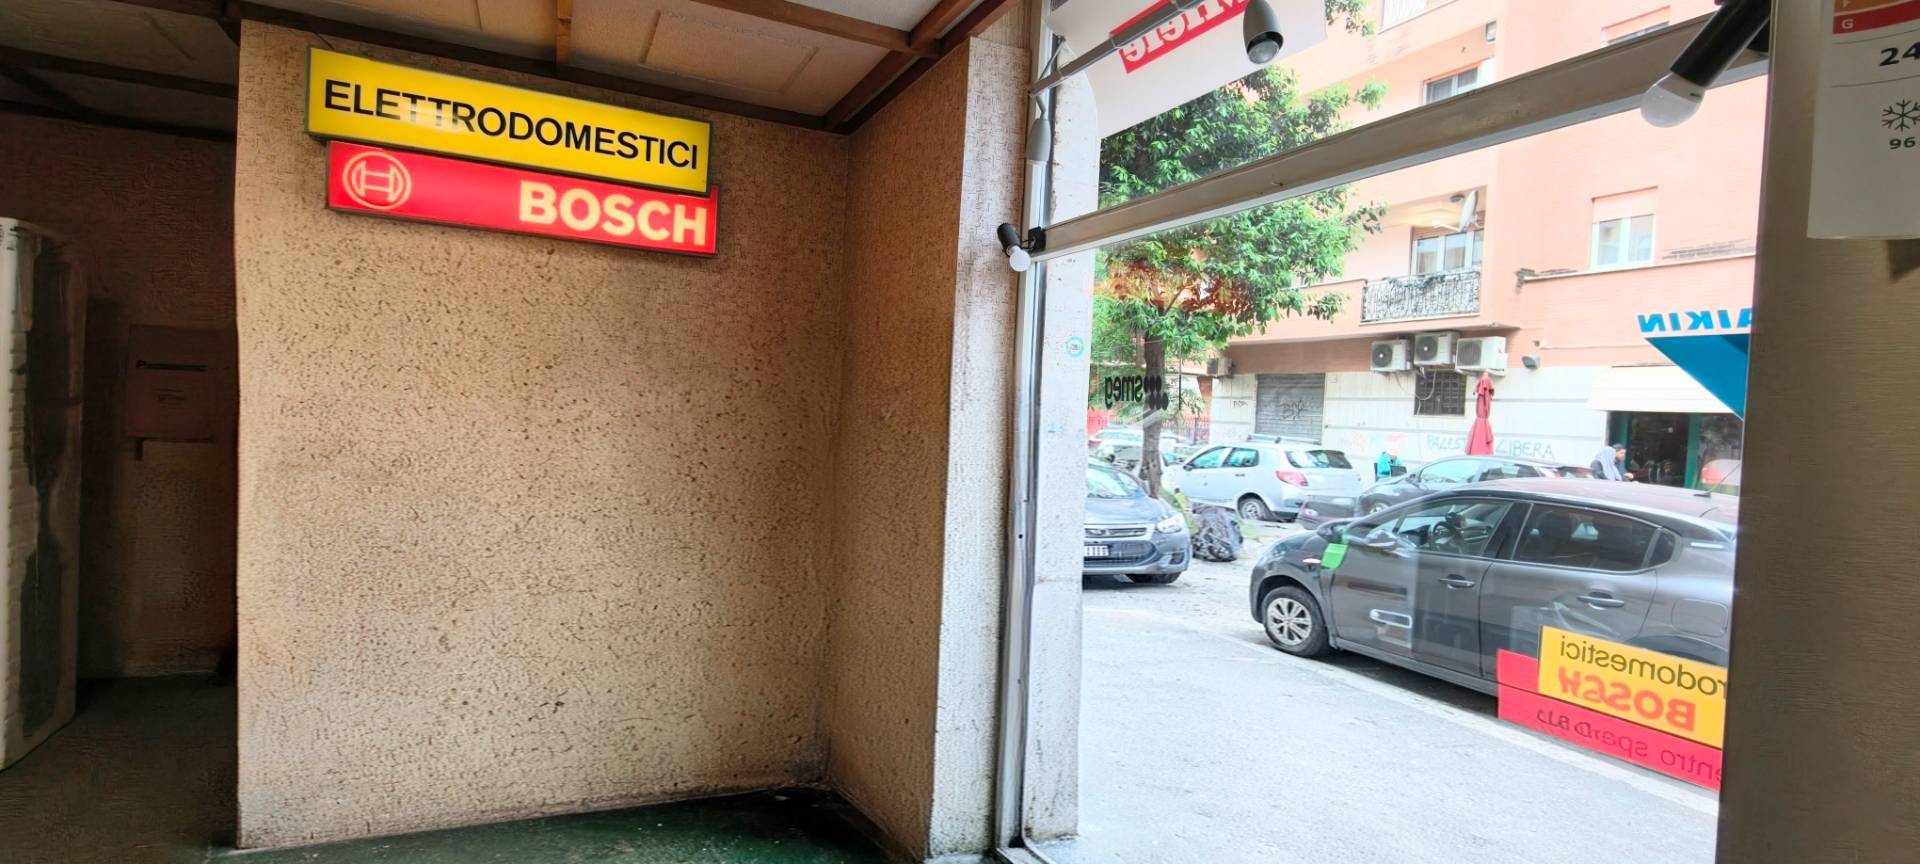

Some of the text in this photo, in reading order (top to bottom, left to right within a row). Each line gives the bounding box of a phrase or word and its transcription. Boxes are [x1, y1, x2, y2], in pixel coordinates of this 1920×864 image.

[1841, 18, 1854, 29] G
[324, 78, 699, 170] ELETTRODOMESTICI
[519, 180, 707, 246] BOSCH
